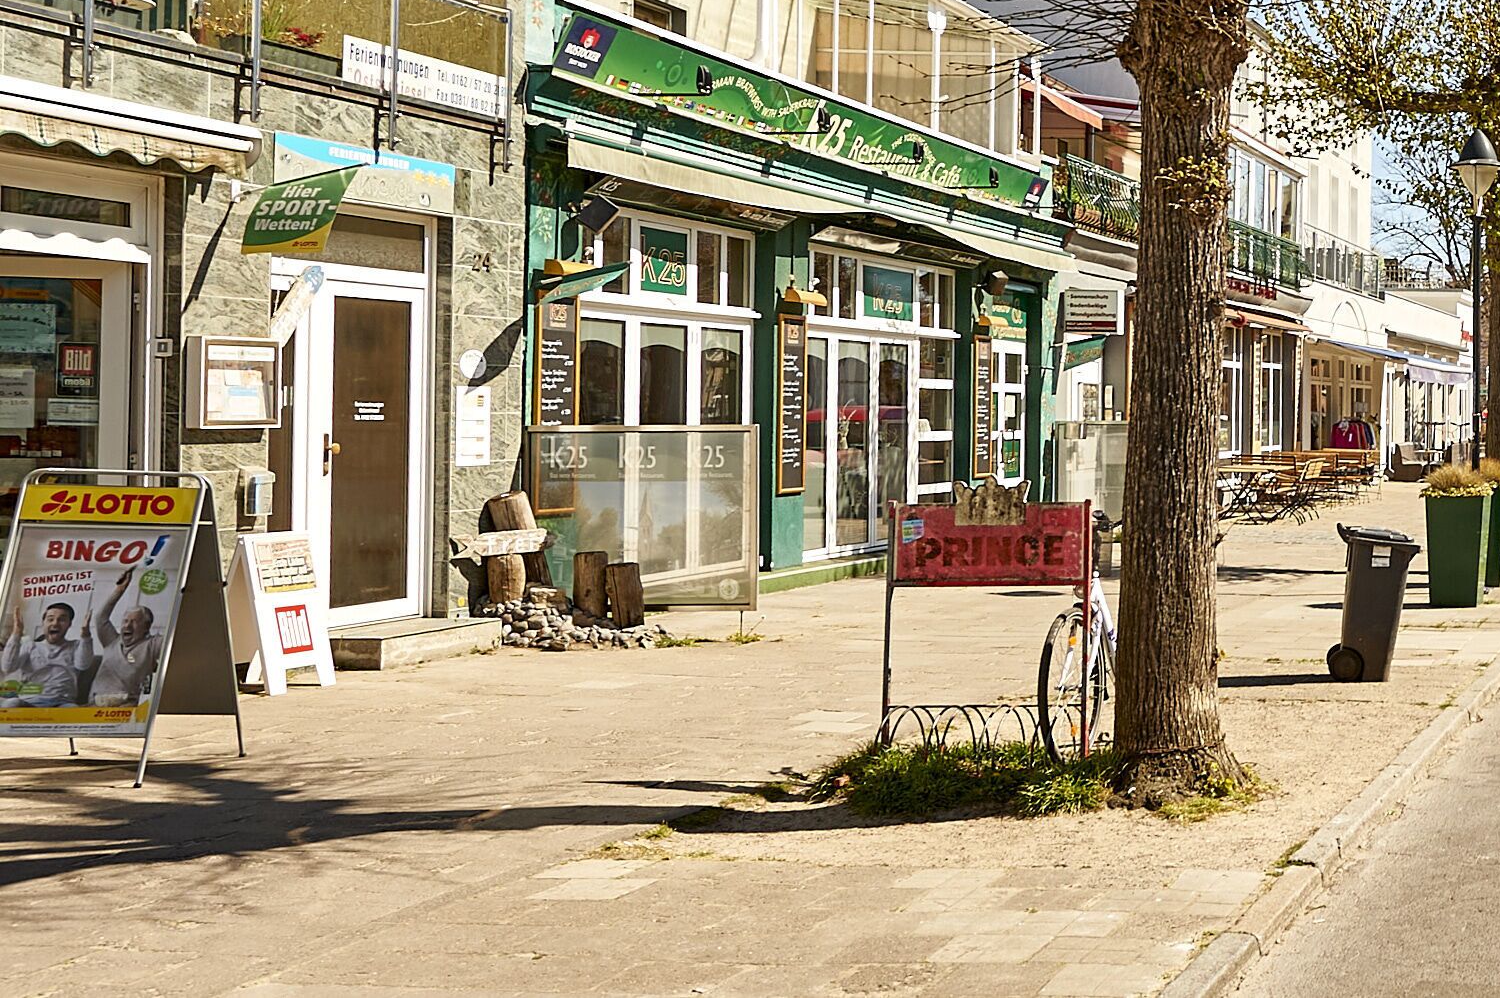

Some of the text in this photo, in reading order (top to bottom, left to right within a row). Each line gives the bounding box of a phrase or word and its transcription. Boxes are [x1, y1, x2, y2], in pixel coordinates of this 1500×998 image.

[281, 184, 322, 199] Hier
[255, 199, 338, 217] SPORT-
[253, 217, 317, 232] Wetten!
[472, 253, 492, 273] 24
[64, 349, 92, 371] Bild
[64, 378, 92, 387] mobil
[79, 493, 176, 516] LOTTO
[45, 534, 171, 566] BINGO!
[914, 534, 1066, 567] PRINCE
[23, 570, 93, 586] SONNTAG IST
[22, 582, 95, 598] BINGO! TAG.
[104, 710, 132, 718] LOTTO
